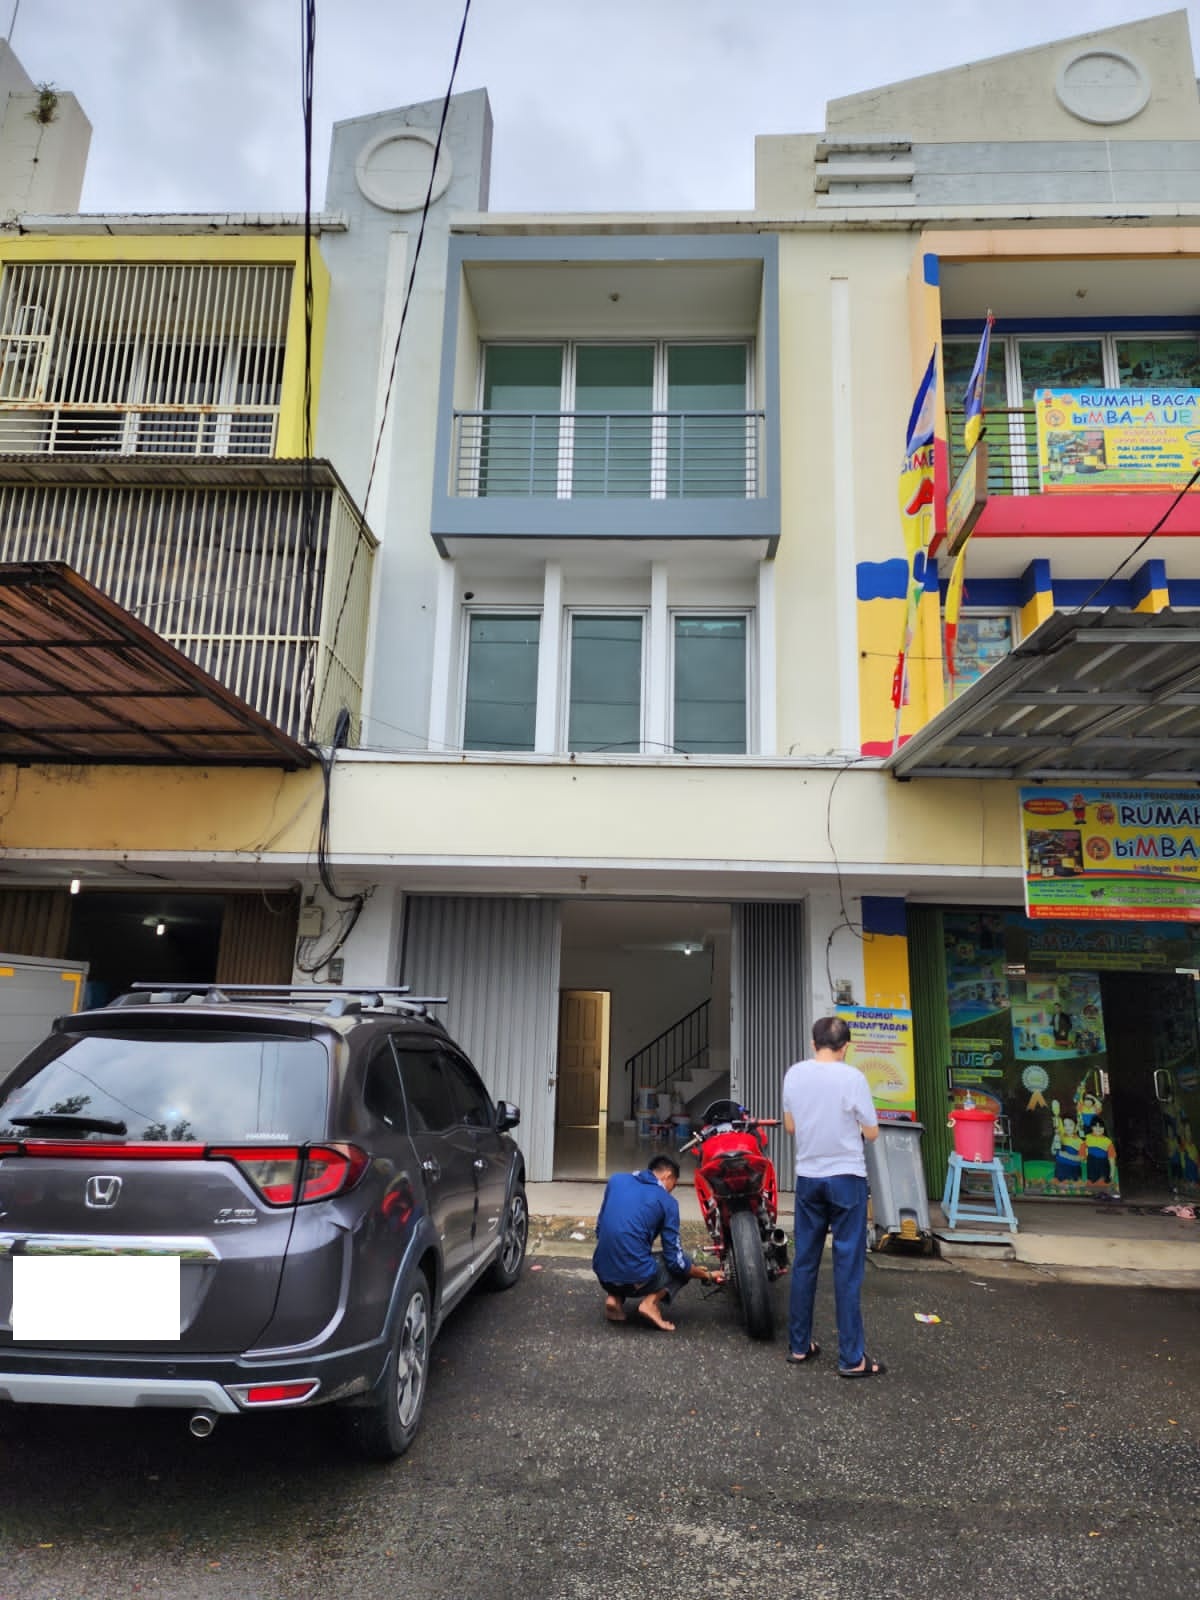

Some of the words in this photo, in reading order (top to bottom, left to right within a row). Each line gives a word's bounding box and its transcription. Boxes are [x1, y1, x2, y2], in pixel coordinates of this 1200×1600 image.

[1080, 394, 1145, 407] RUMAH
[1151, 394, 1197, 407] BACA
[847, 1021, 909, 1032] ENDAFTARAN
